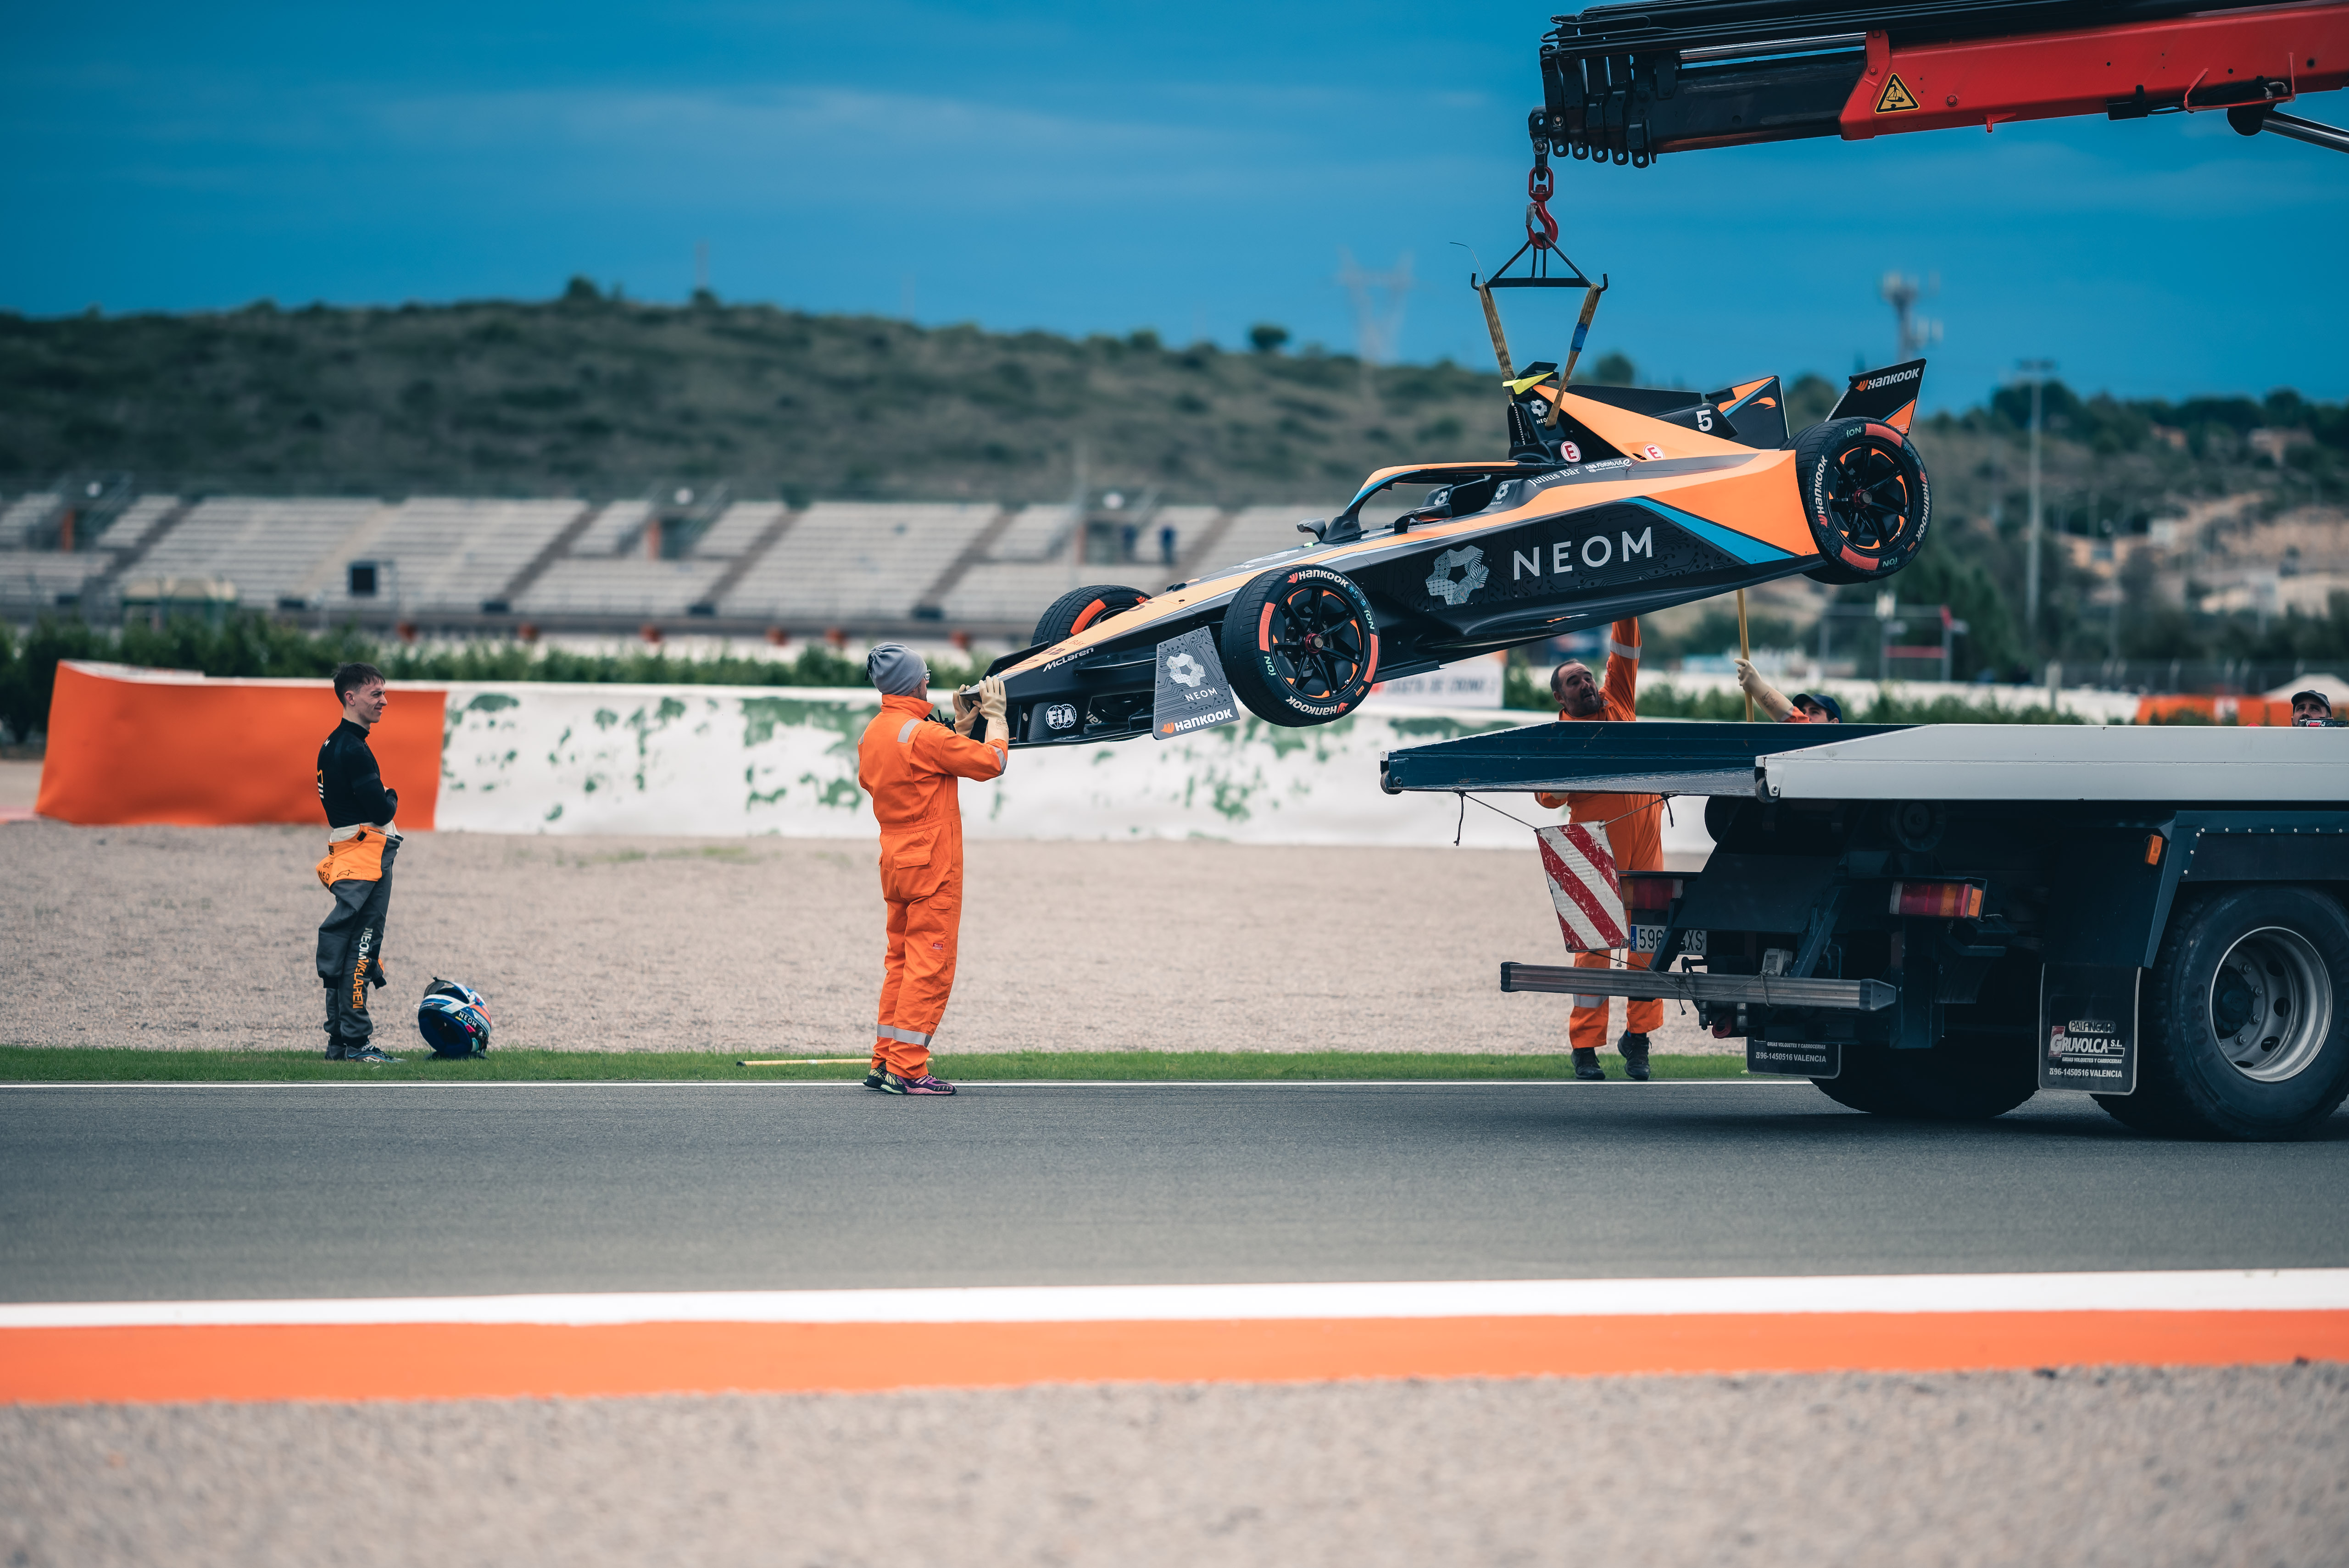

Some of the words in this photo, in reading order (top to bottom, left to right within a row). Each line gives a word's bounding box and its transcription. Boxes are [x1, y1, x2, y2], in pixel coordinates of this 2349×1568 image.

[1696, 409, 1713, 432] 5
[1564, 445, 1577, 460] E
[1647, 447, 1661, 459] E
[1596, 460, 1624, 468] FORMULA
[1527, 473, 1560, 487] Julius
[1559, 468, 1581, 477] Bär
[1514, 527, 1653, 580] NEOM
[1042, 647, 1094, 673] McLaren
[1185, 687, 1218, 702] NEOM
[318, 869, 330, 881] NEO
[357, 927, 373, 960] NEOM
[1639, 929, 1664, 949] 596
[1686, 930, 1703, 951] XS
[459, 1012, 477, 1028] NEOM
[2050, 1033, 2108, 1055] GRUVOLCA
[1760, 1052, 1793, 1061] 96-1450516
[1793, 1054, 1827, 1063] VALENCIA
[2054, 1068, 2089, 1077] 96-1450516
[2089, 1069, 2123, 1078] VALENCIA
